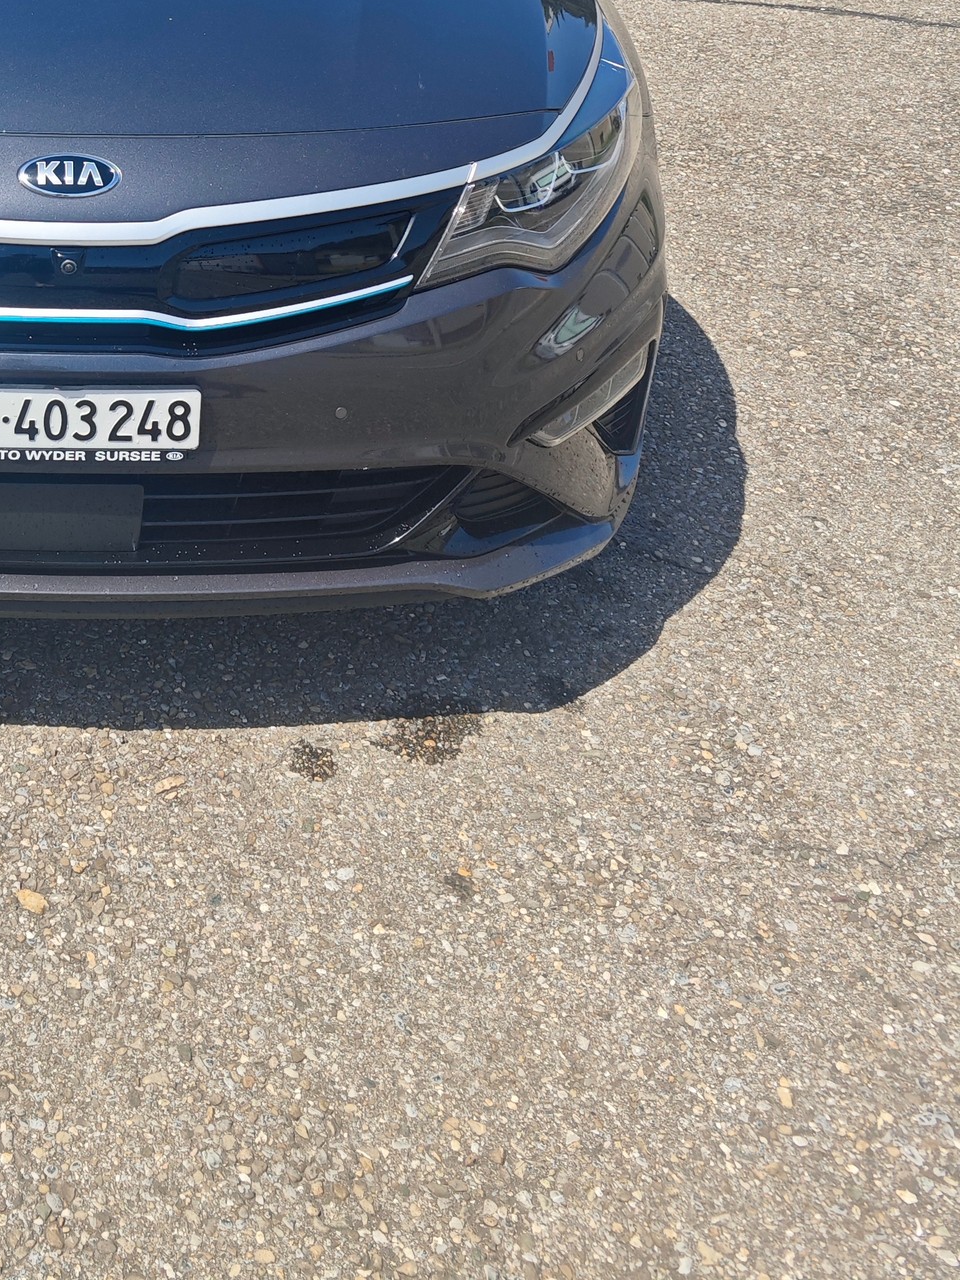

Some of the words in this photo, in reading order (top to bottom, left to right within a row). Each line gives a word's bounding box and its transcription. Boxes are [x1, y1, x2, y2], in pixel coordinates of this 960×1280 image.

[37, 161, 104, 186] KIA
[25, 450, 86, 461] WYDER
[94, 450, 161, 462] SURSEE
